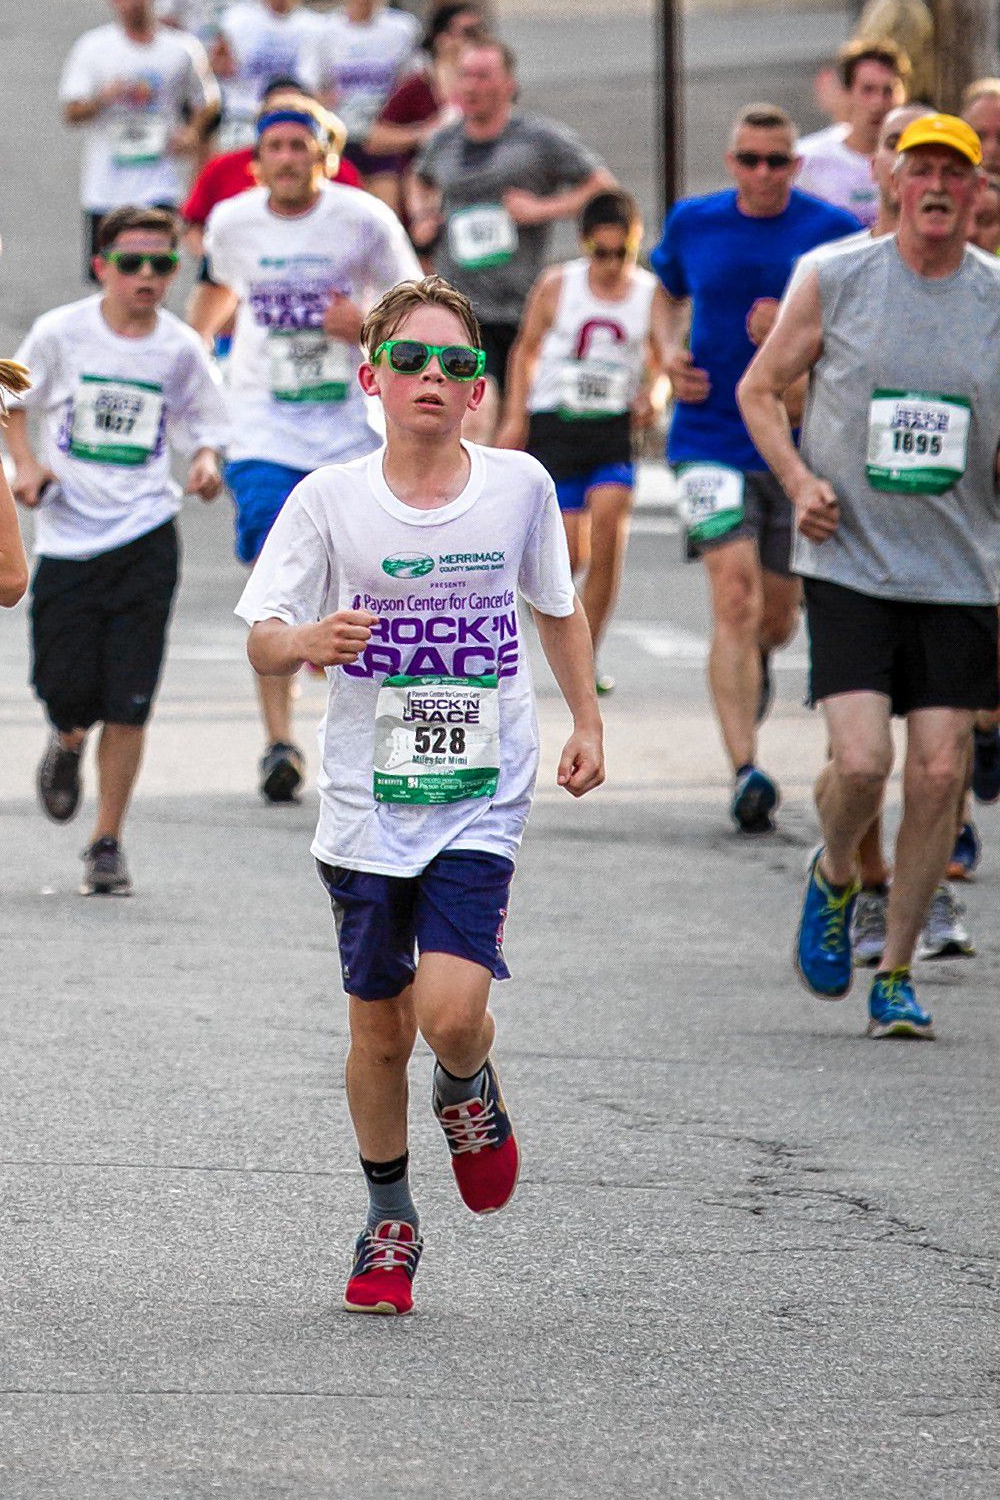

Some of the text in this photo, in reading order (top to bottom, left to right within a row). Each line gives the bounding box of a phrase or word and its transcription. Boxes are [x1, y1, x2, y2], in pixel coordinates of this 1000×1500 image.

[893, 431, 942, 456] 1695
[438, 550, 506, 565] MERRIMACK
[439, 565, 464, 573] COUNTY
[465, 564, 490, 572] SAVINGS
[430, 580, 467, 589] PRESENTS
[364, 594, 405, 615] Payson
[407, 593, 448, 612] Center
[449, 592, 466, 610] for
[469, 592, 504, 610] Cancer
[368, 610, 519, 646] ROCK'N
[362, 640, 520, 680] RACE
[411, 699, 481, 710] ROCK'N
[410, 709, 481, 724] RACE
[414, 726, 466, 755] 528
[411, 754, 468, 765] Miles for Mimi
